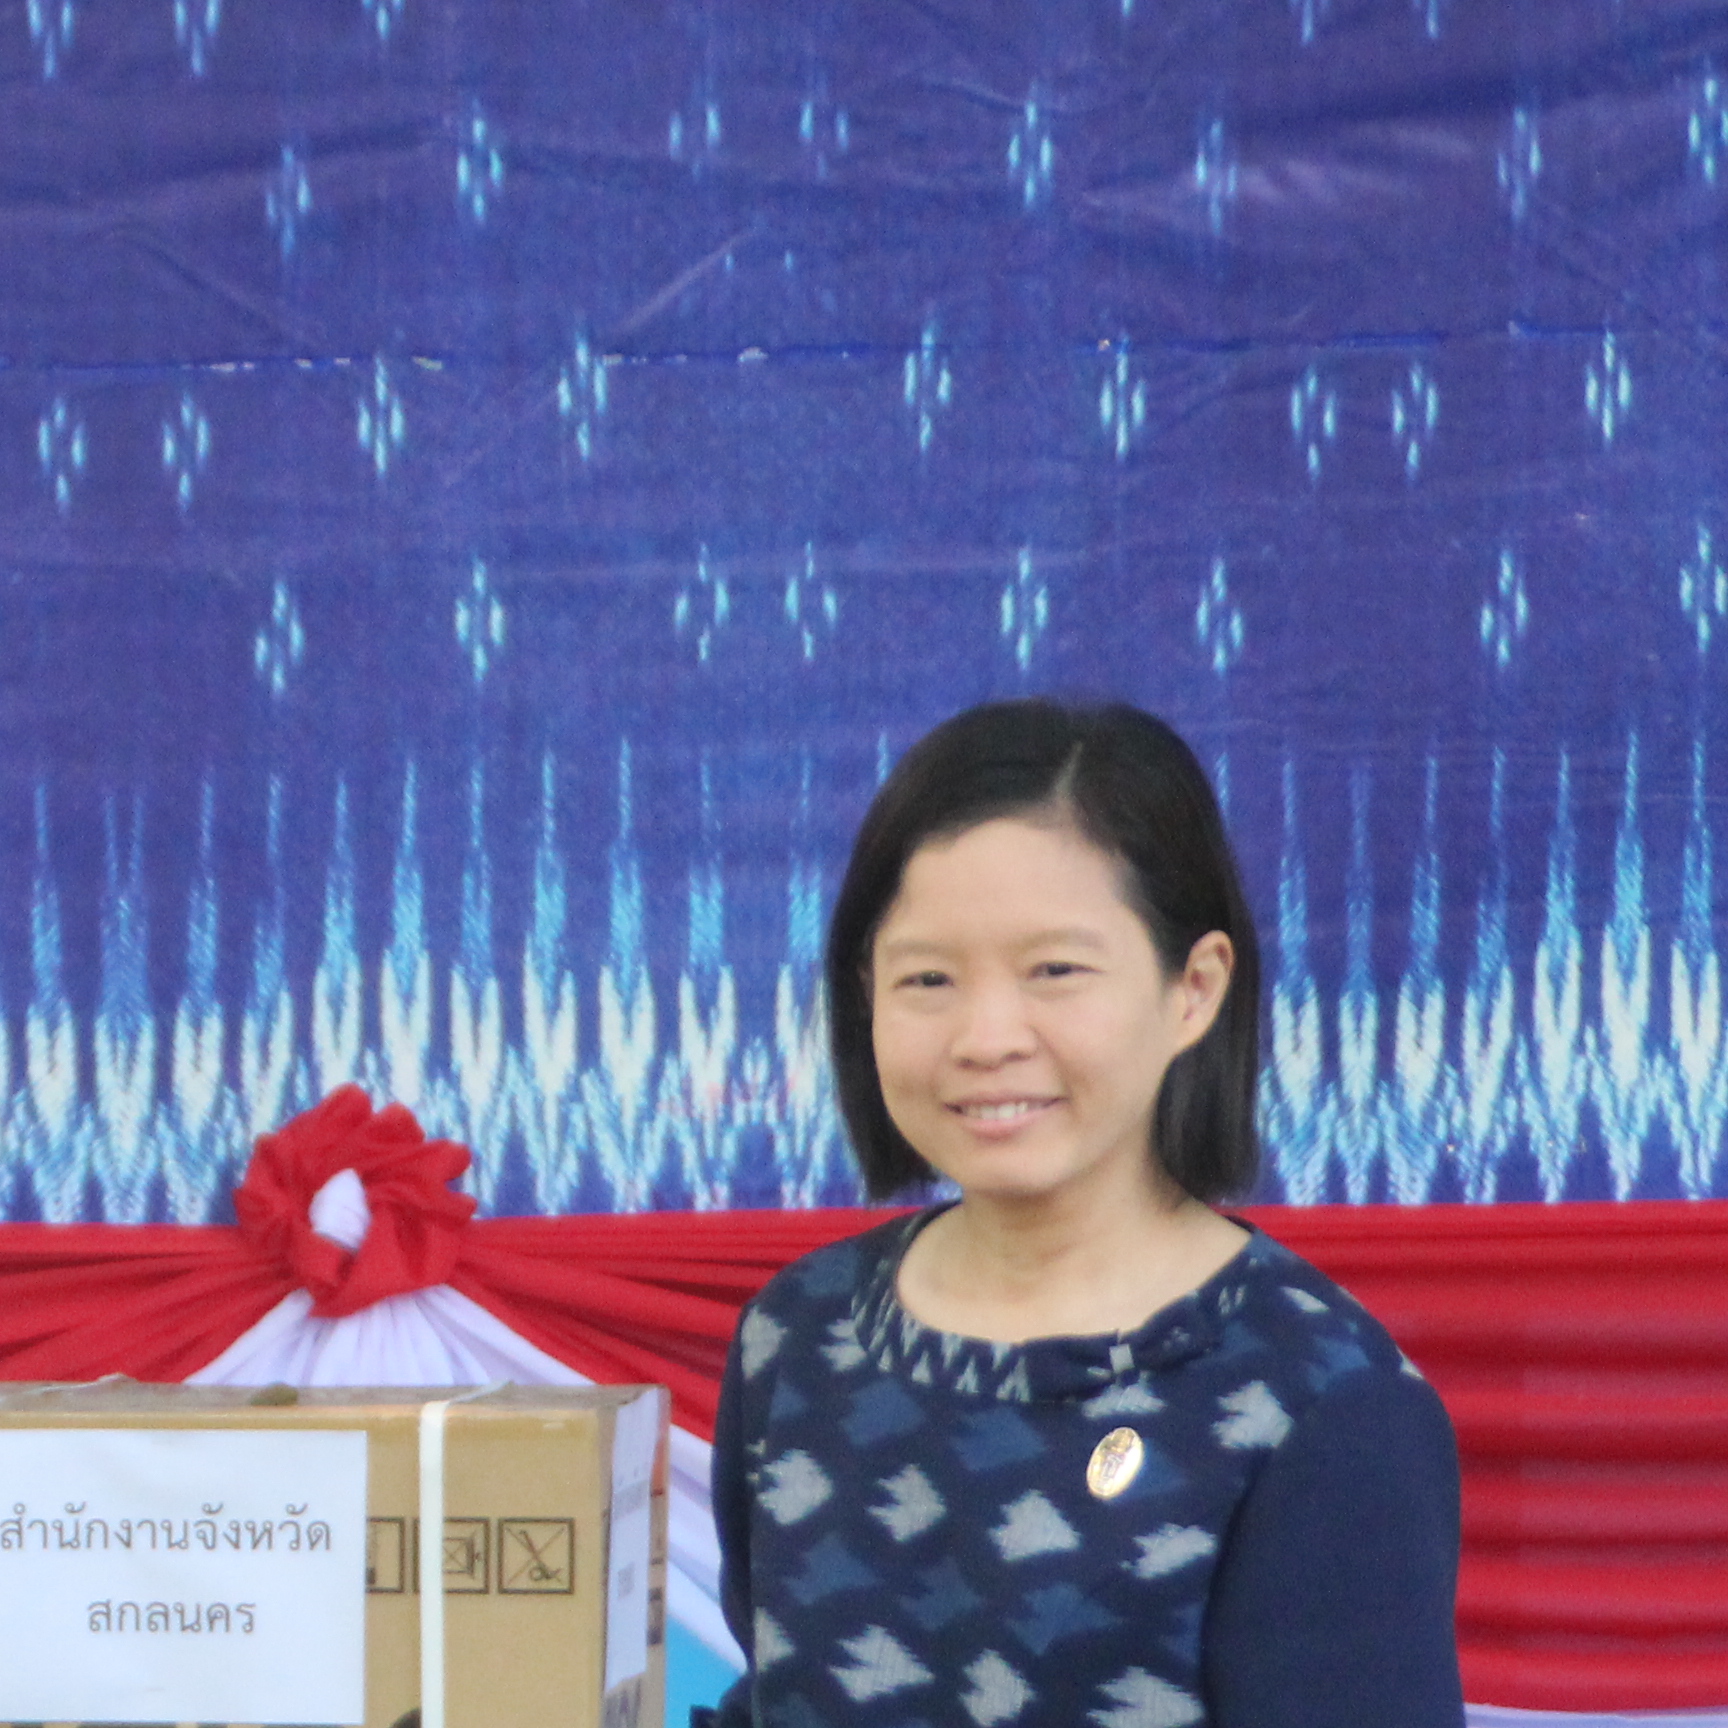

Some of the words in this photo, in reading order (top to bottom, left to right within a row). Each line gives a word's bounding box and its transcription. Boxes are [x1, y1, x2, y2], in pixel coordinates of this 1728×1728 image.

[0, 1501, 331, 1551] สำนักงานจังหวัด
[87, 1599, 256, 1633] สกลนคร
